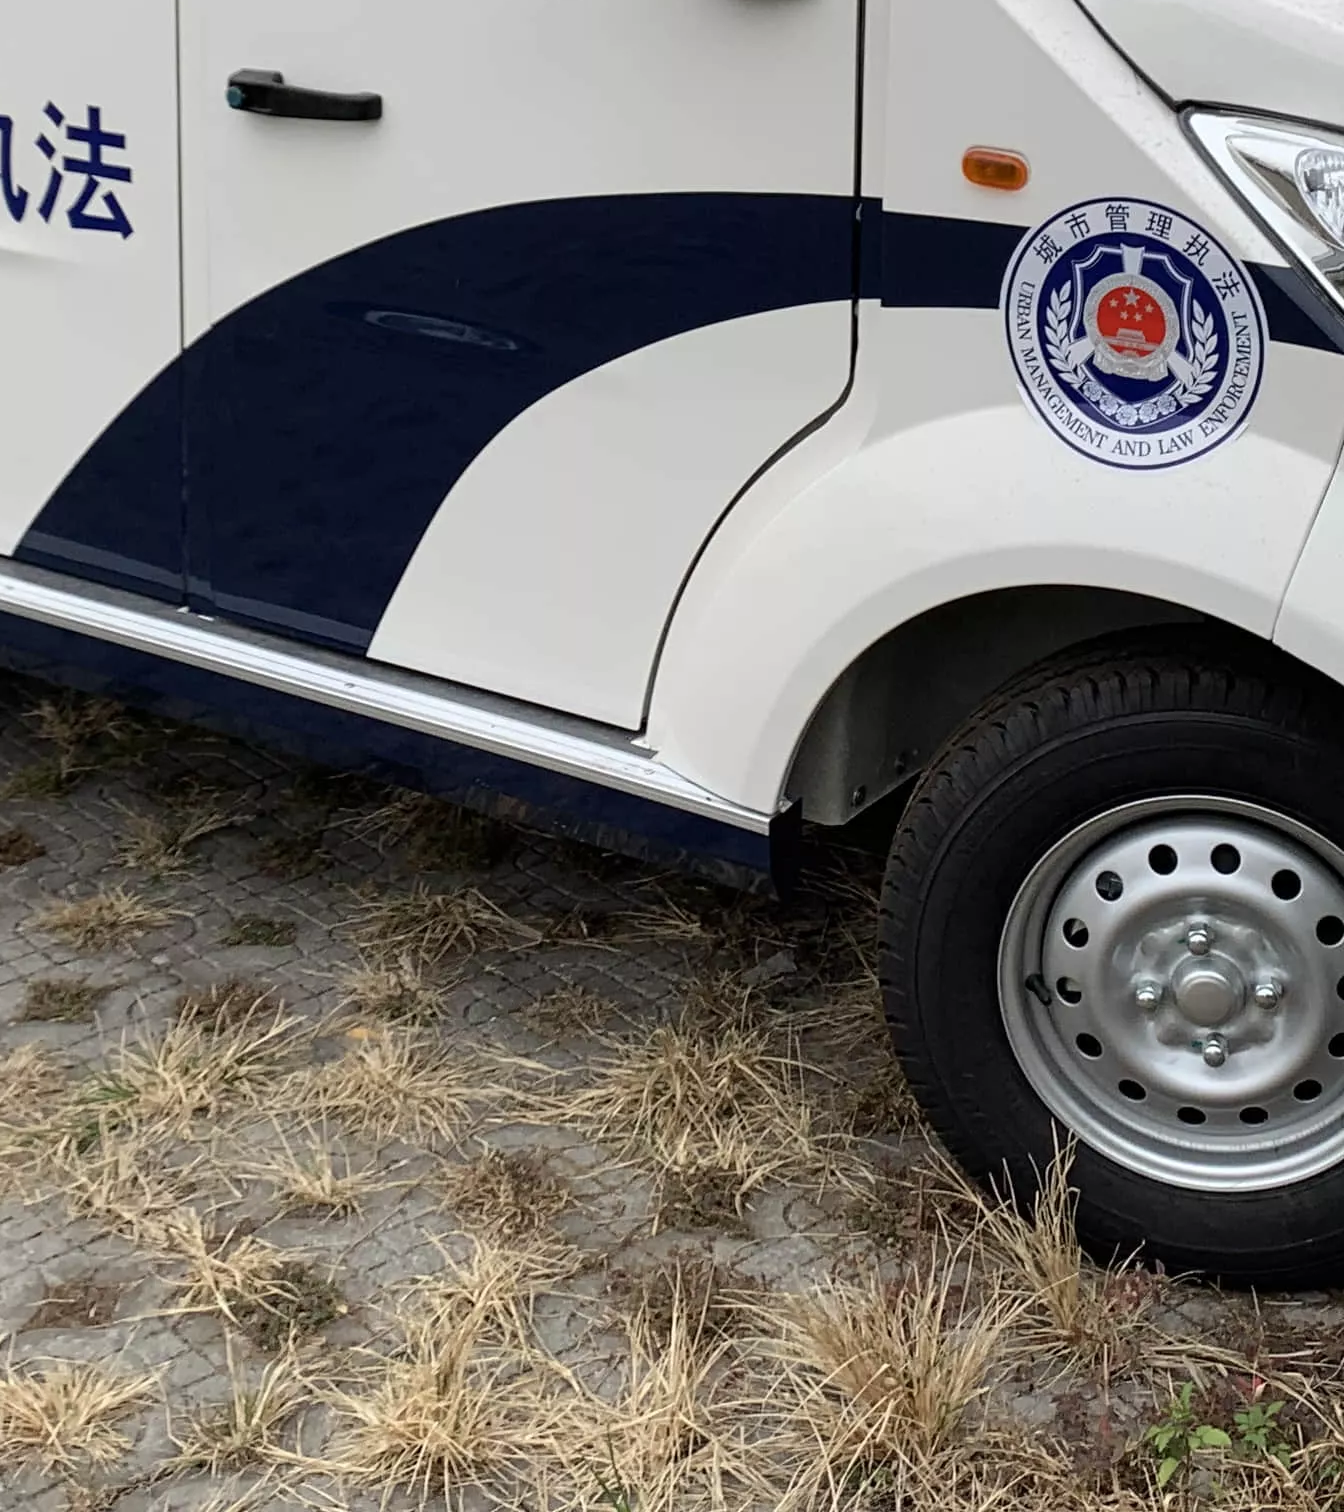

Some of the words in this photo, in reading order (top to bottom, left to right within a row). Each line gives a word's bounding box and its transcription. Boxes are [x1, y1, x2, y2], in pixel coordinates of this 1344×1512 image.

[1032, 203, 1242, 301] 城市管理执法
[1015, 281, 1036, 340] URBAN
[1020, 347, 1109, 449] MANAGEMENT
[1197, 310, 1253, 439] ENFORCEMENT
[1112, 440, 1151, 457] AND
[1158, 429, 1194, 456] LAW
